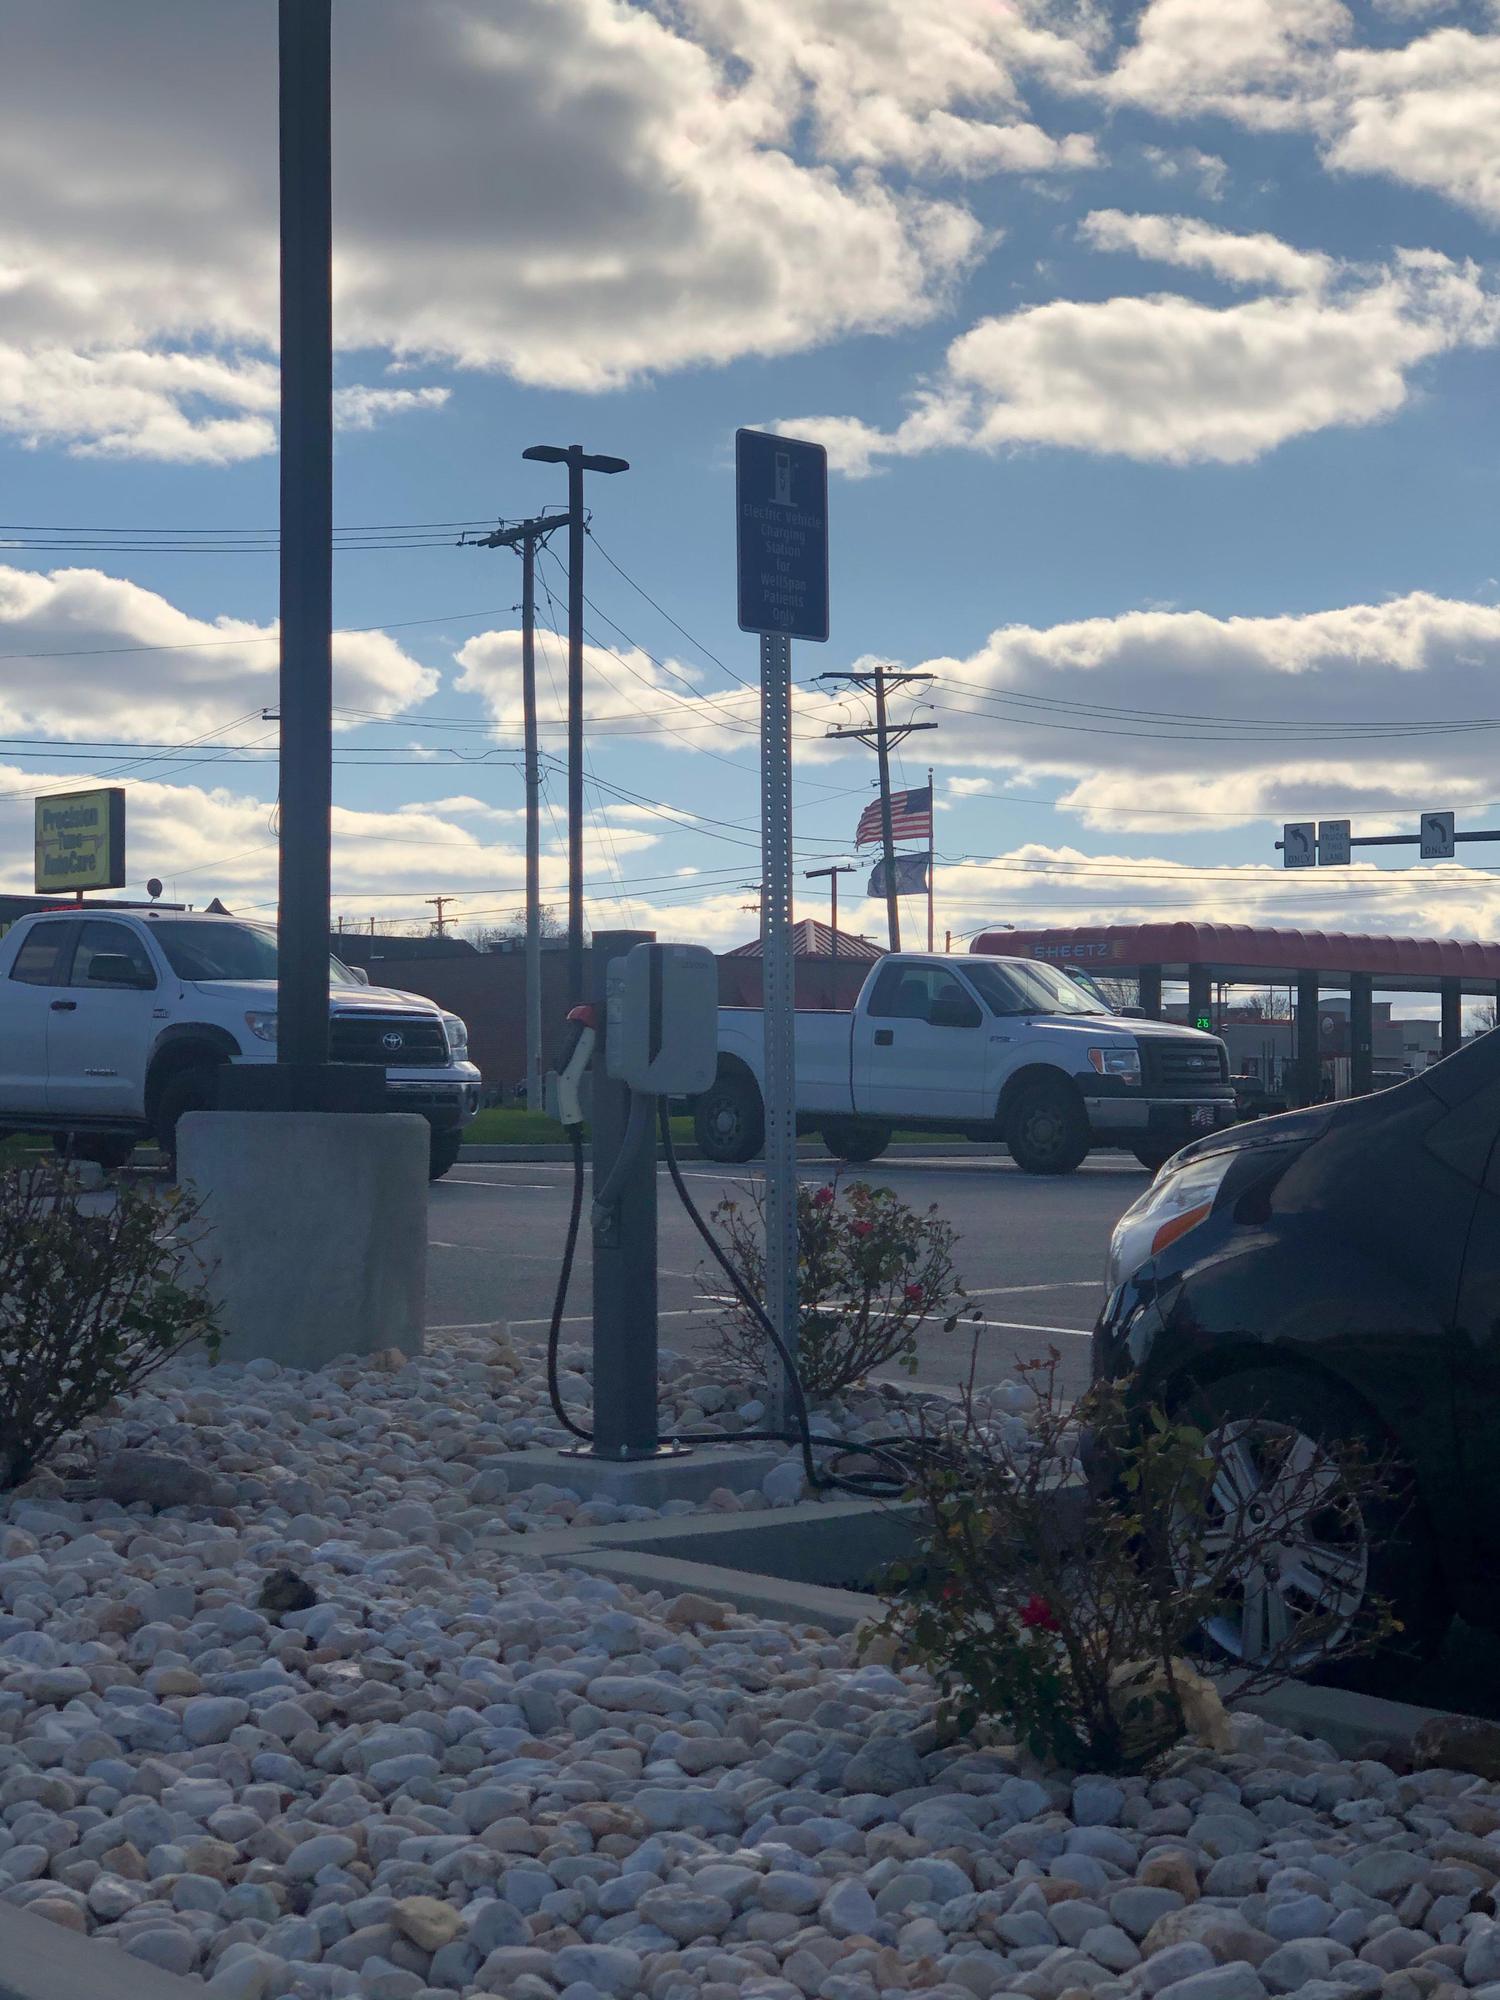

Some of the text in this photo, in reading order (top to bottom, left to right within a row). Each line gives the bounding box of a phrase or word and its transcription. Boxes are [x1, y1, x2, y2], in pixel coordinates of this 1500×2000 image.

[744, 503, 821, 529] Electric Vehicle
[760, 523, 806, 544] Charging
[766, 540, 801, 557] Station
[1288, 854, 1311, 864] ONLY
[1425, 846, 1449, 856] ONLY
[1034, 943, 1108, 959] SHEETZ
